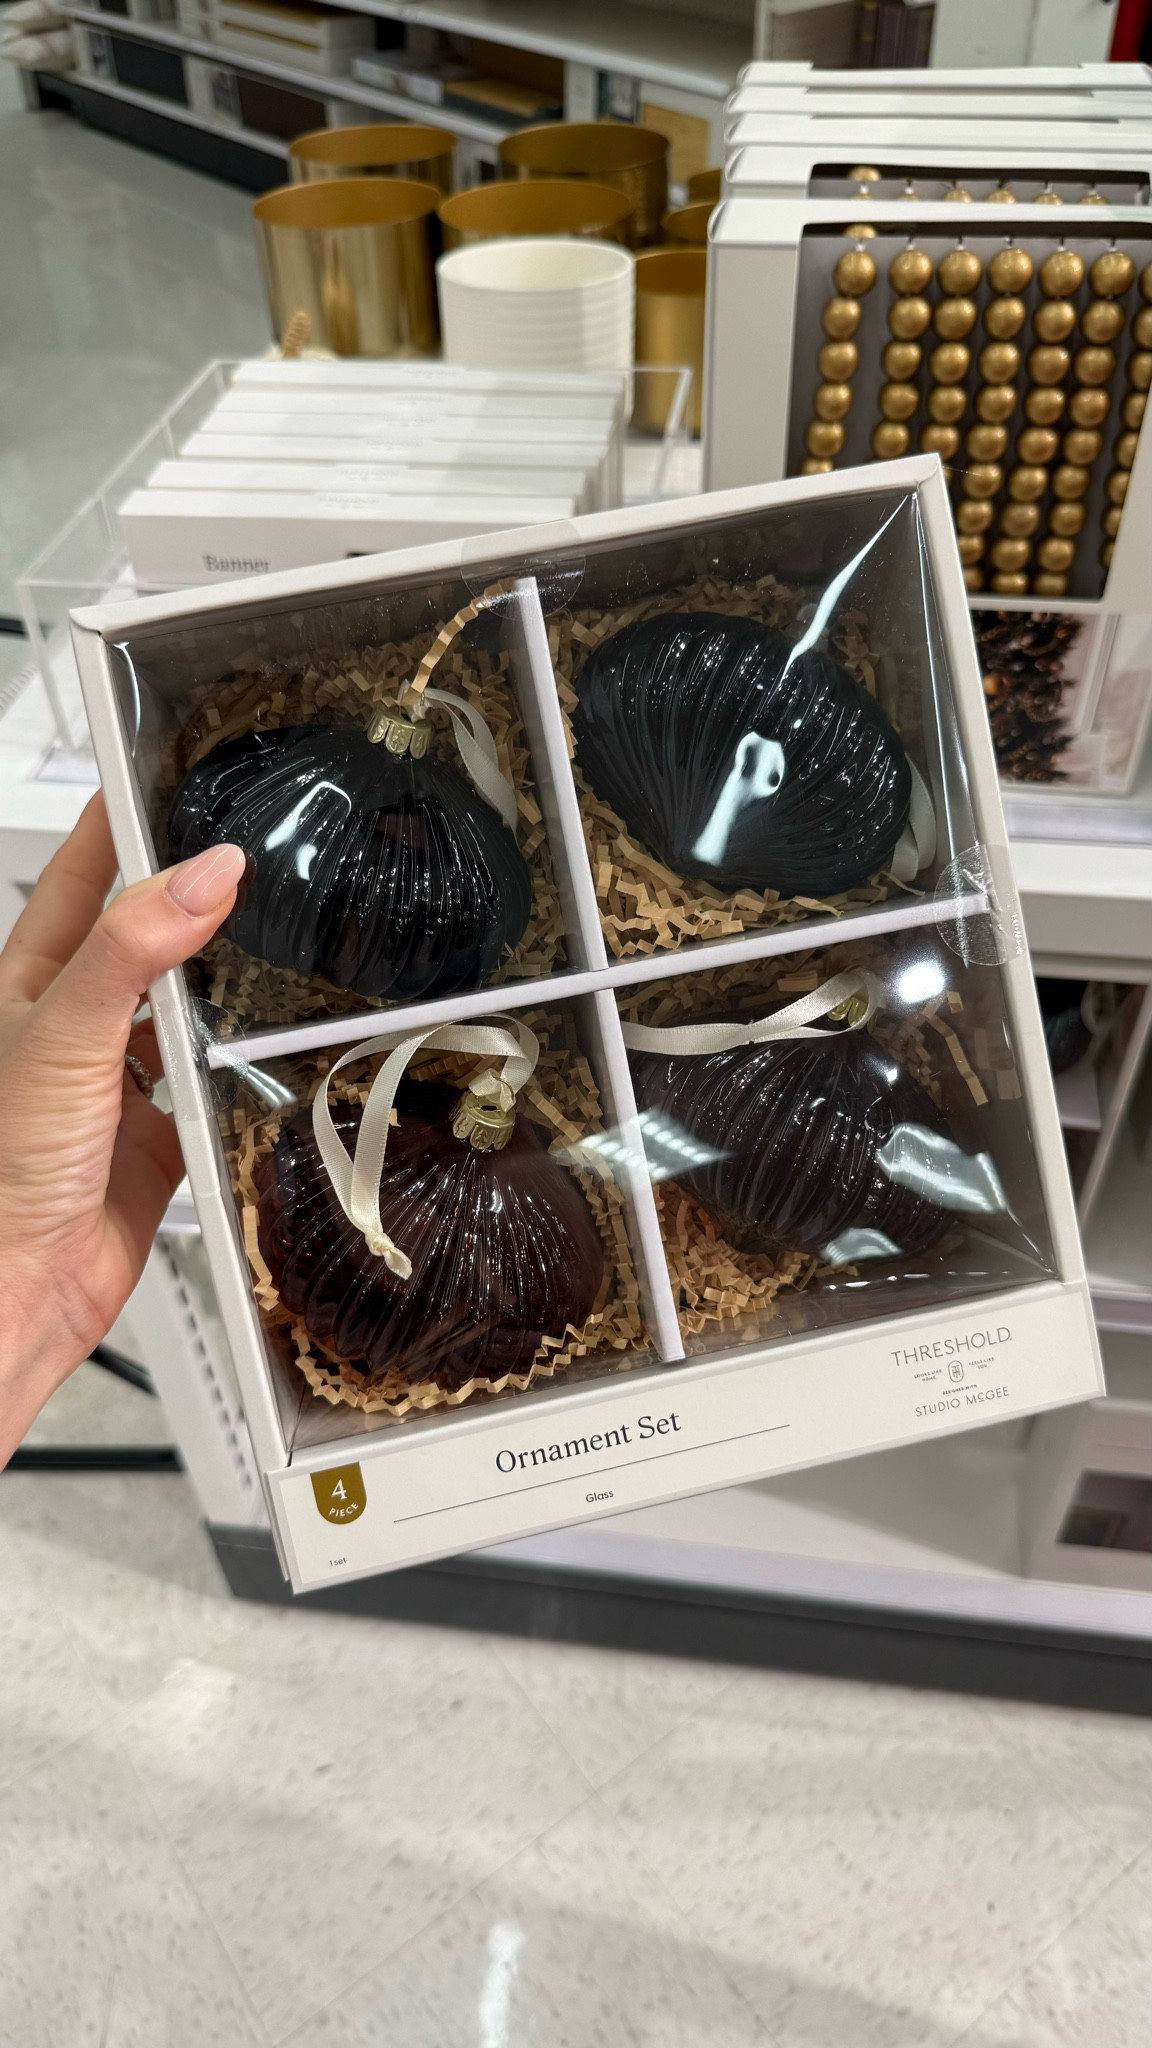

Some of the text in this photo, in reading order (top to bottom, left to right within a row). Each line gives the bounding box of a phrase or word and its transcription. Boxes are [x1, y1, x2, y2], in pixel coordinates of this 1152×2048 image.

[203, 555, 270, 573] Banner
[891, 1326, 1011, 1366] THRESHOLD
[915, 1398, 961, 1417] STUDIO
[495, 1412, 682, 1474] Ornament Set
[331, 1478, 348, 1500] 4
[585, 1490, 614, 1503] Glass
[329, 1502, 359, 1517] PIECE
